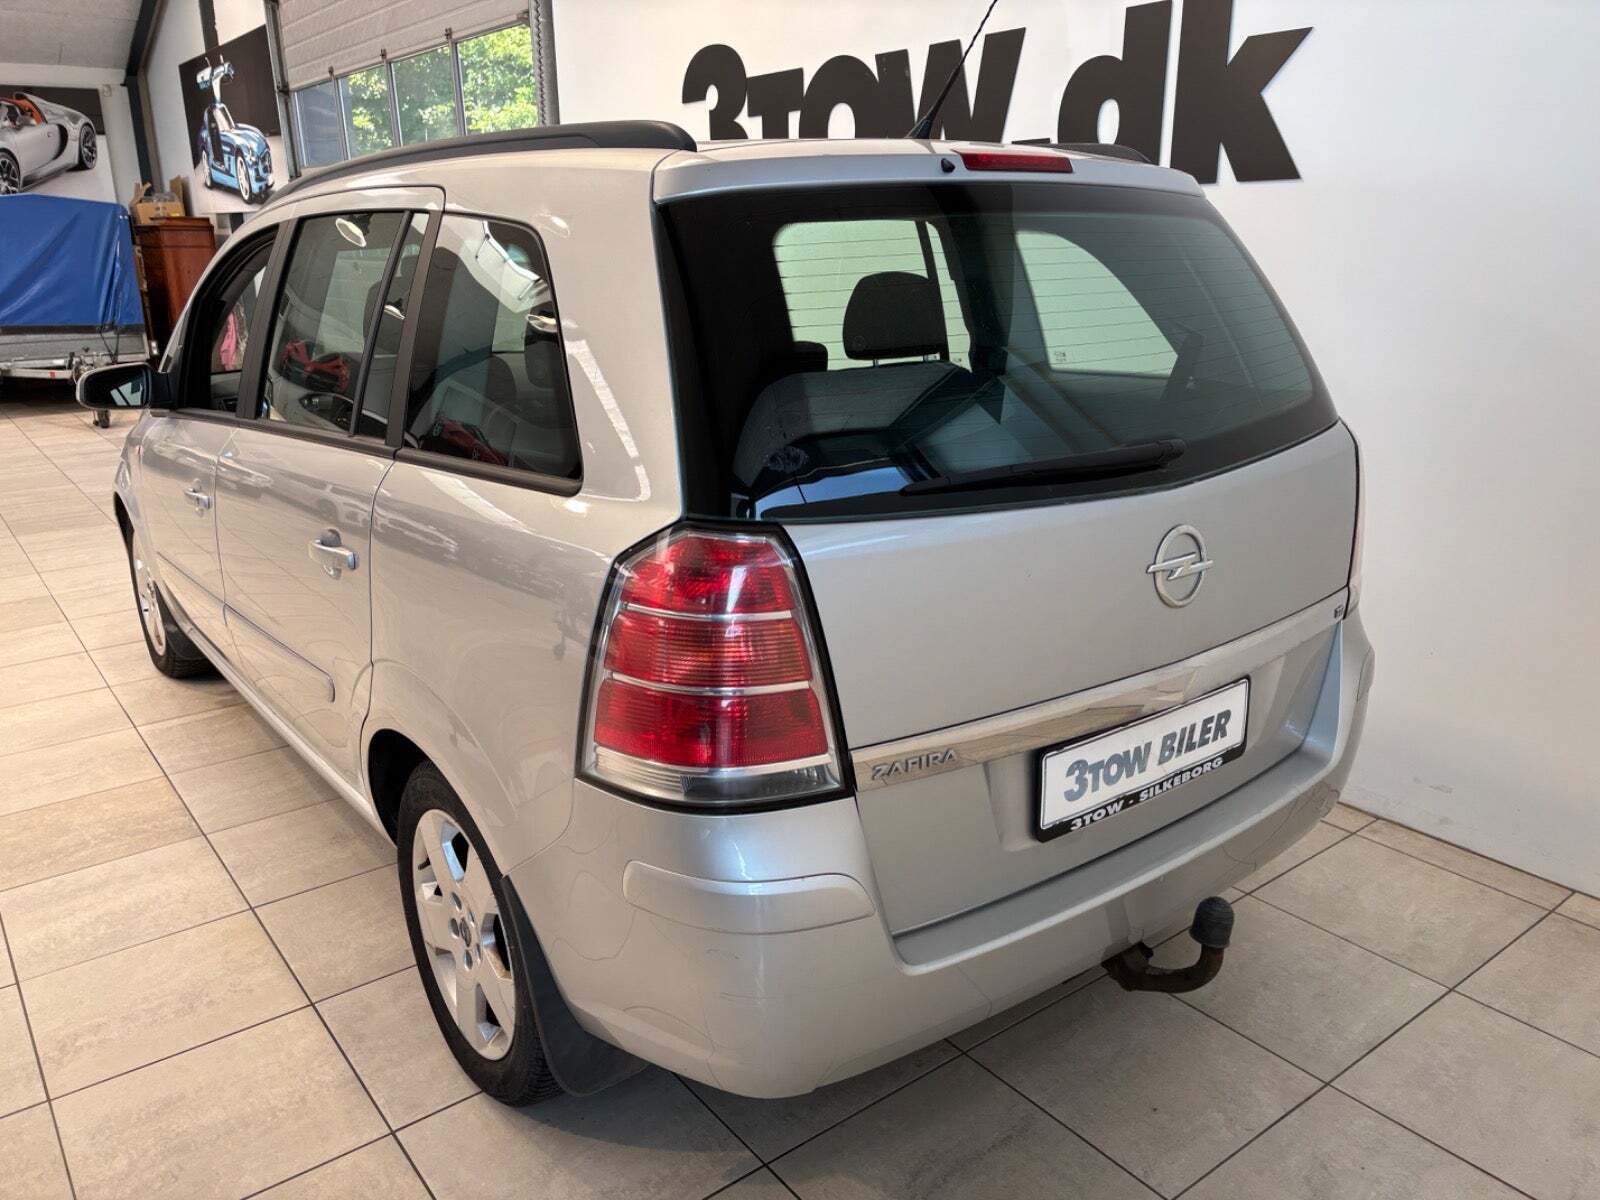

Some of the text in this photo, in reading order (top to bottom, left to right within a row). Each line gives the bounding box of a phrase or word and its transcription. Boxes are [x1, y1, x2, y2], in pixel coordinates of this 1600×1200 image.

[872, 748, 958, 781] ZAFIRA
[1064, 709, 1232, 803] 3TOW BILER
[1070, 800, 1125, 831] 3TOW
[1139, 757, 1223, 801] SILKEBORG
